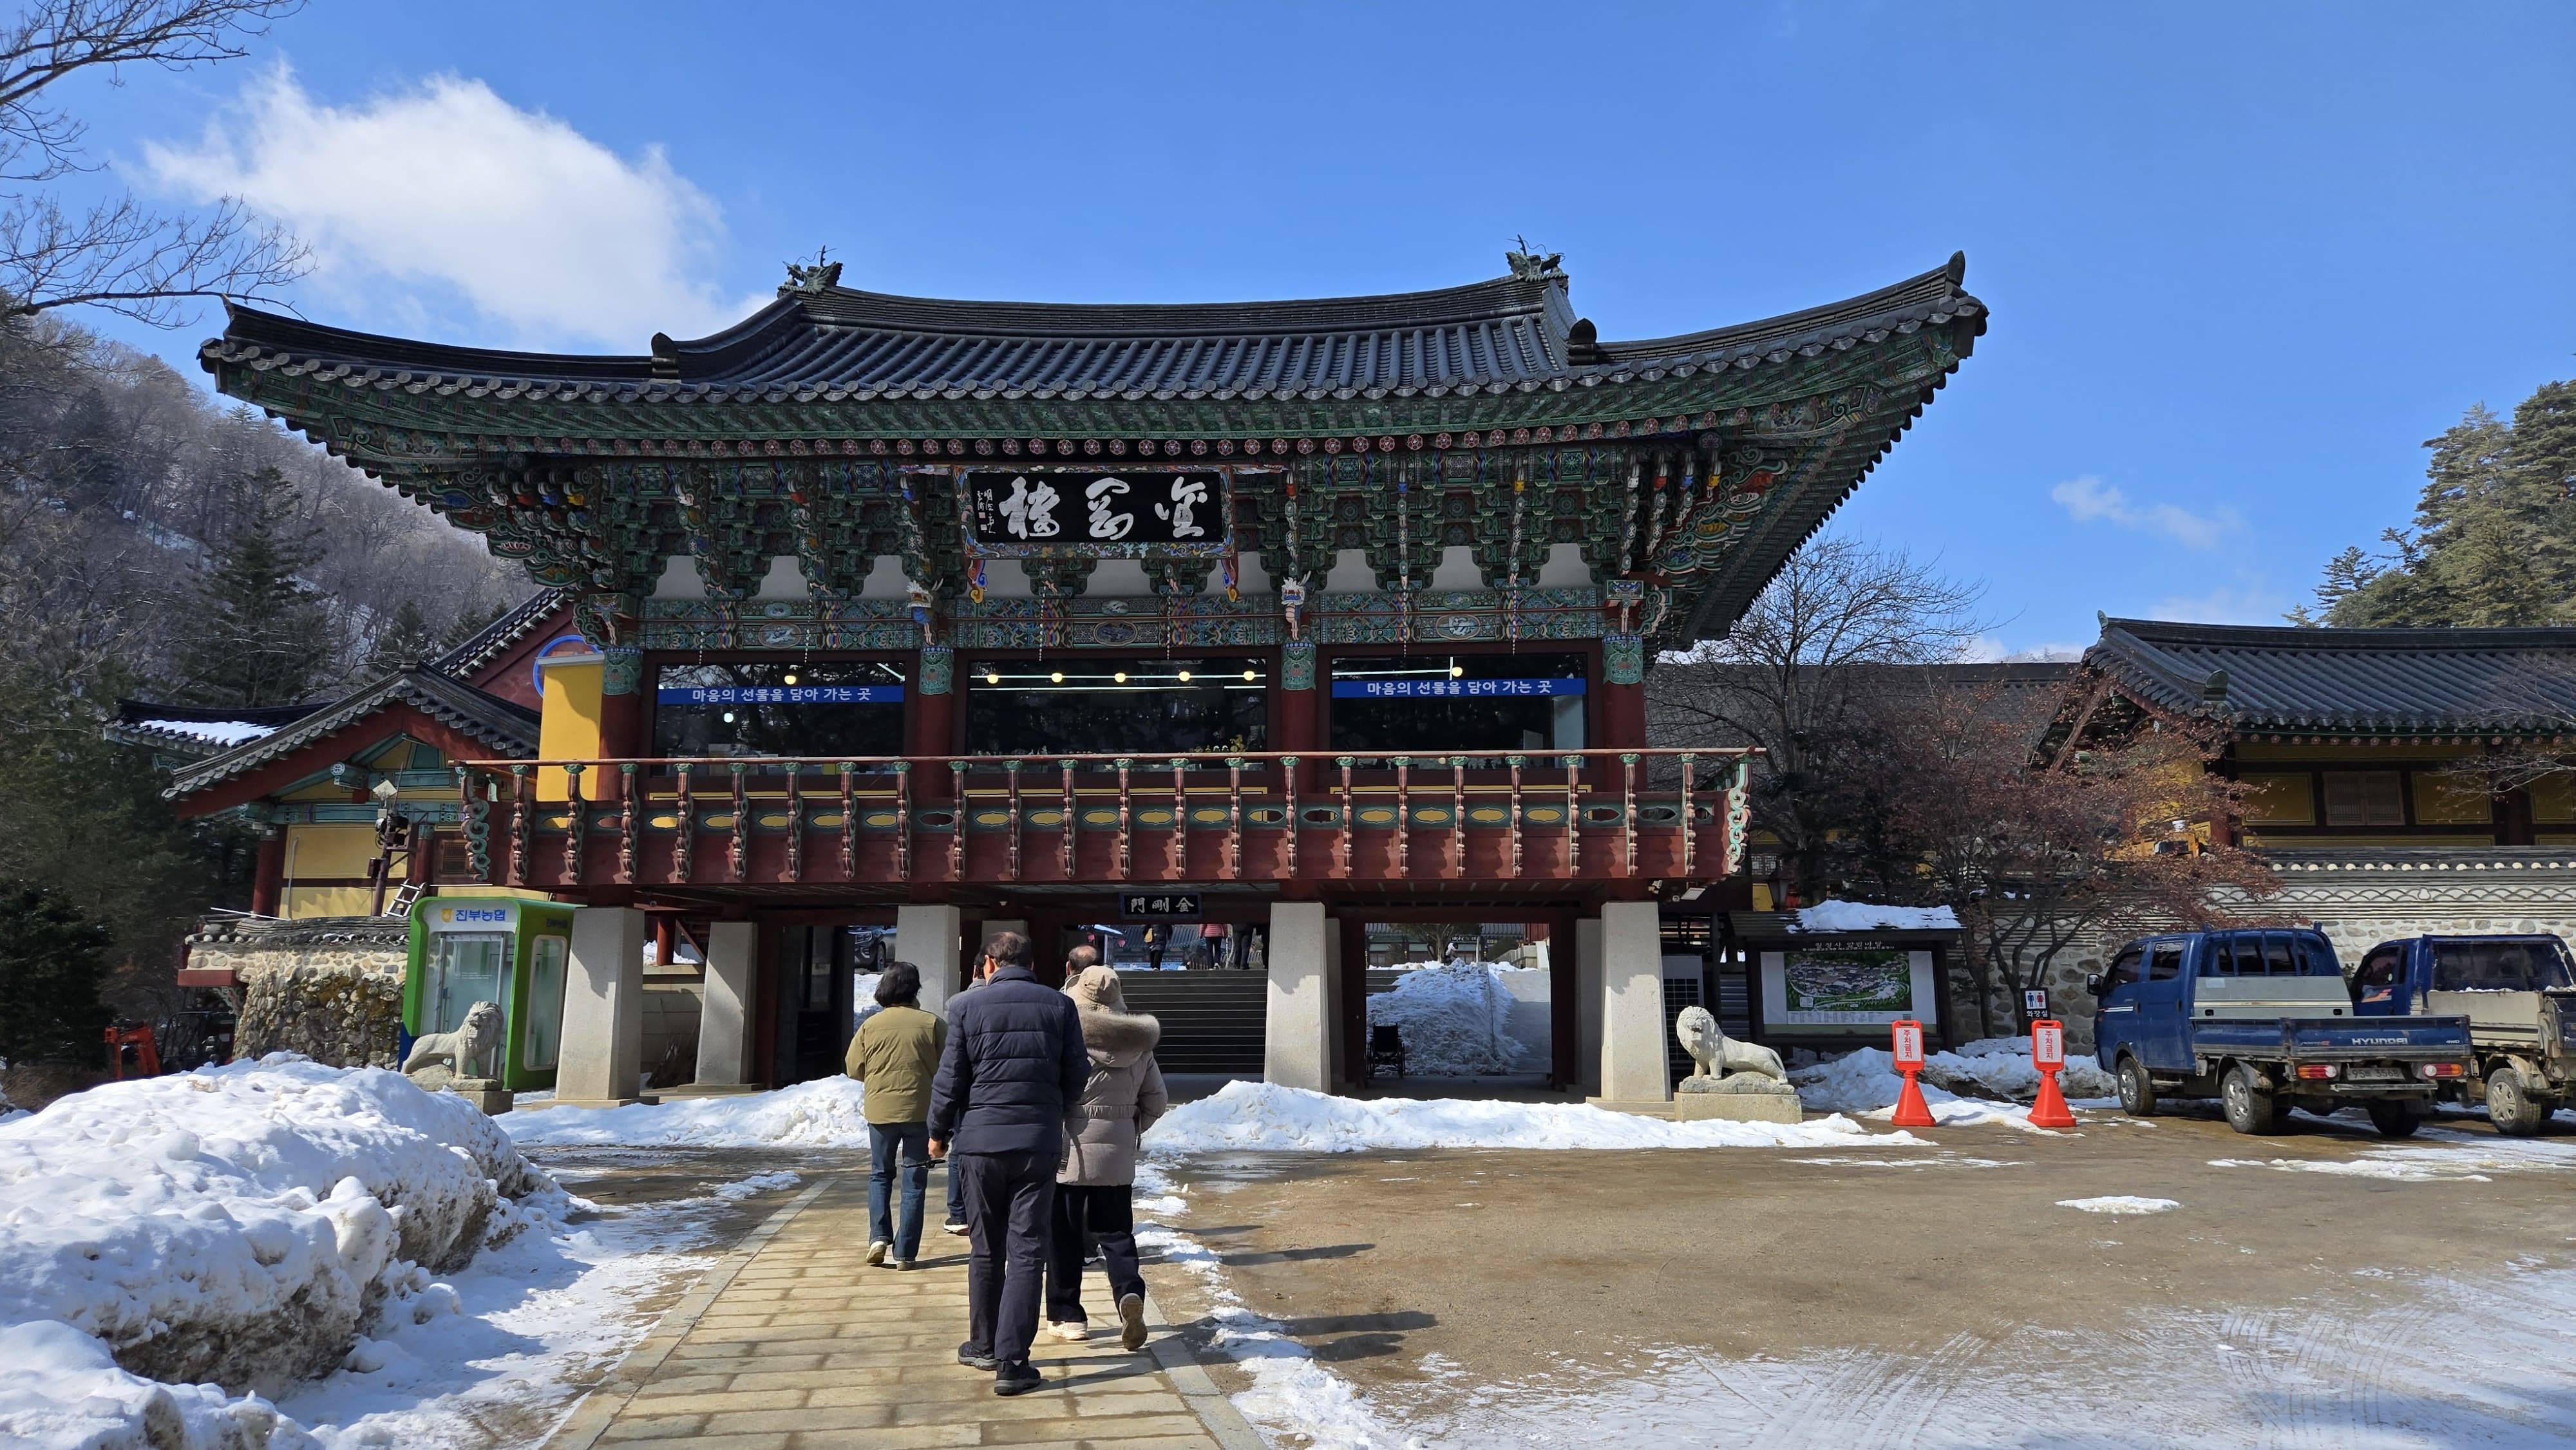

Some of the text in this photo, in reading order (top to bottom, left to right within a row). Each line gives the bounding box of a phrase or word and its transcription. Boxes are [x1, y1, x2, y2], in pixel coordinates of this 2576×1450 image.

[1367, 680, 1552, 695] 마음의 선물을 담아 가는 곳
[692, 688, 871, 702] 마음의 선물을 담아 가는 곳
[455, 909, 506, 922] 진부농협
[1903, 1030, 1912, 1059] 주차금지
[2045, 1030, 2053, 1060] 주차금지
[2351, 1037, 2409, 1046] HYUNDAI
